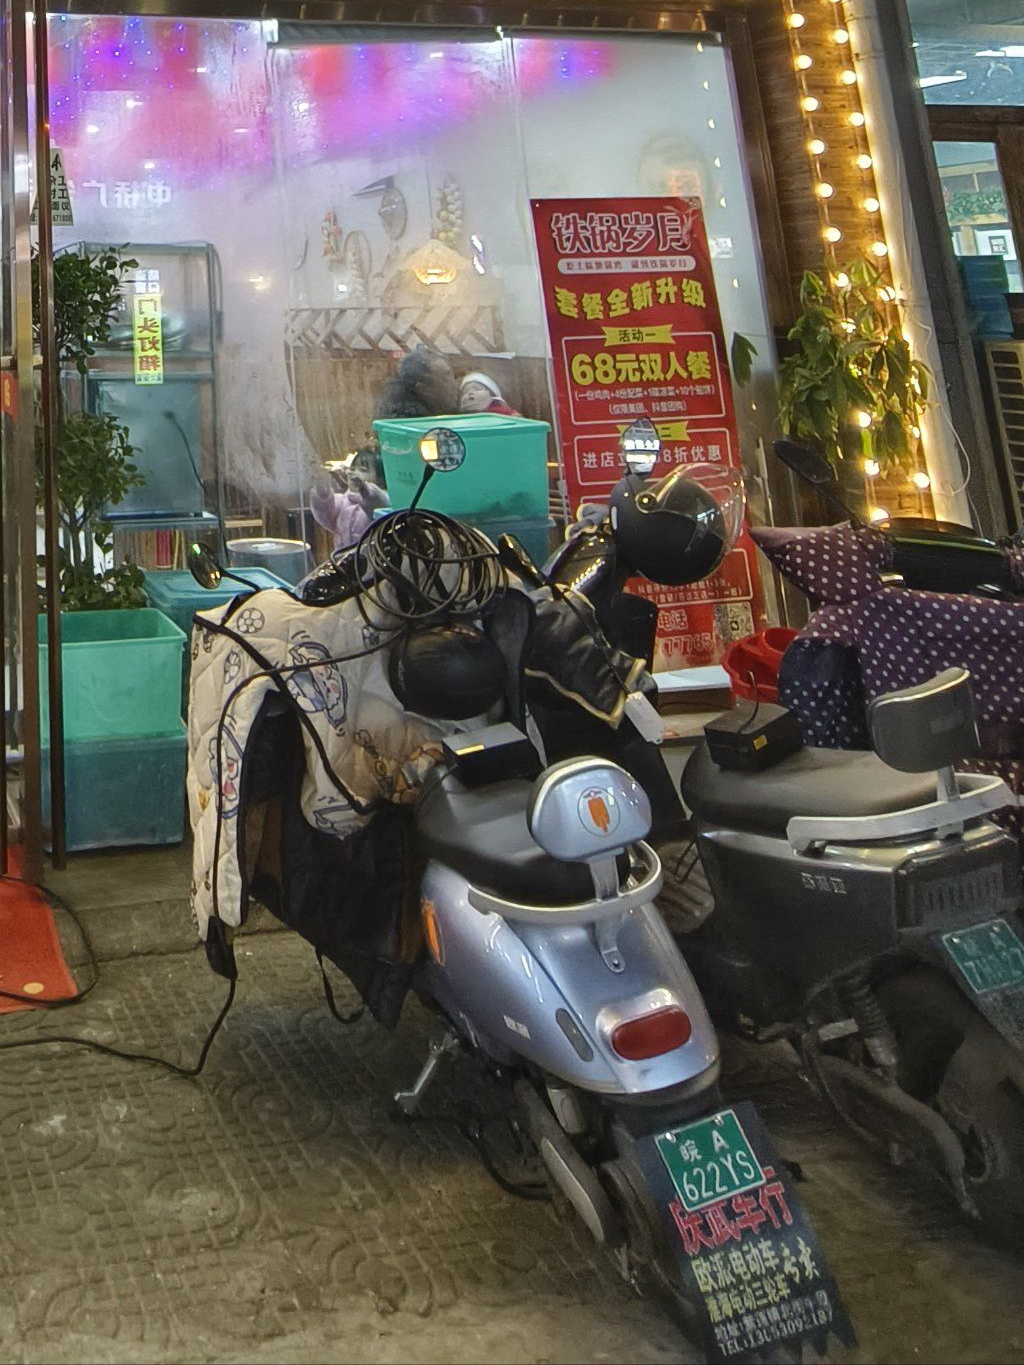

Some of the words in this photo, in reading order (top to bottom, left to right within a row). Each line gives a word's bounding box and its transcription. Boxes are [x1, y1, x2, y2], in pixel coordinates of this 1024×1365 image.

[551, 211, 691, 254] 铁锅岁月
[554, 277, 706, 321] 套餐全新升级
[618, 328, 657, 343] 活动一
[571, 351, 712, 386] 68元双人餐
[679, 1139, 703, 1163] 皖
[712, 1130, 730, 1152] A
[682, 1150, 755, 1202] 622YS
